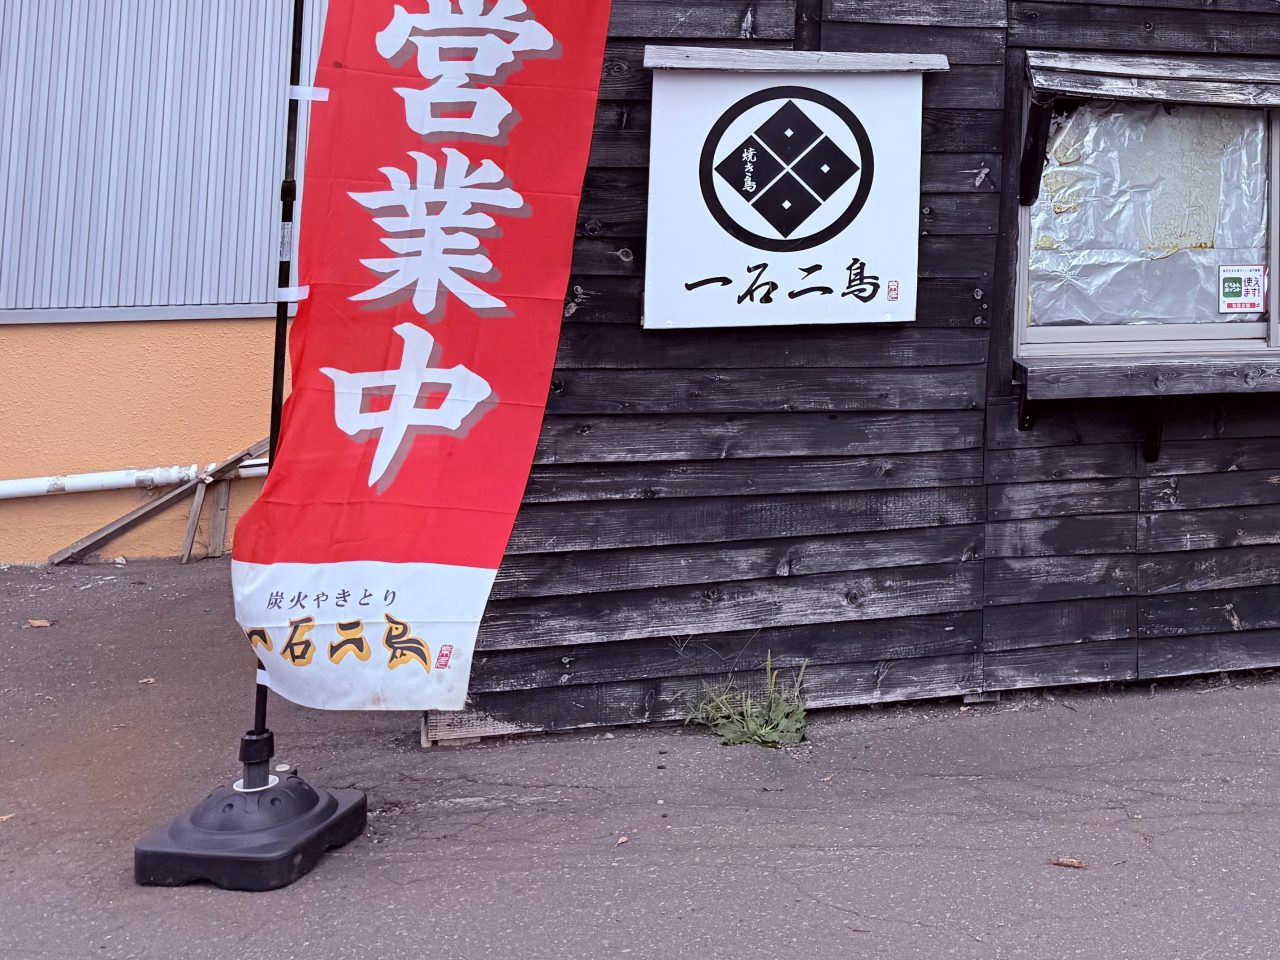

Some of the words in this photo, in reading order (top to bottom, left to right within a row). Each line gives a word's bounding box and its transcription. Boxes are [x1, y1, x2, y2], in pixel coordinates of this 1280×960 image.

[741, 147, 757, 193] 焼き鳥
[684, 258, 881, 305] 一石二鳥
[1244, 277, 1260, 287] 使え
[266, 588, 397, 610] 炭火やきとり
